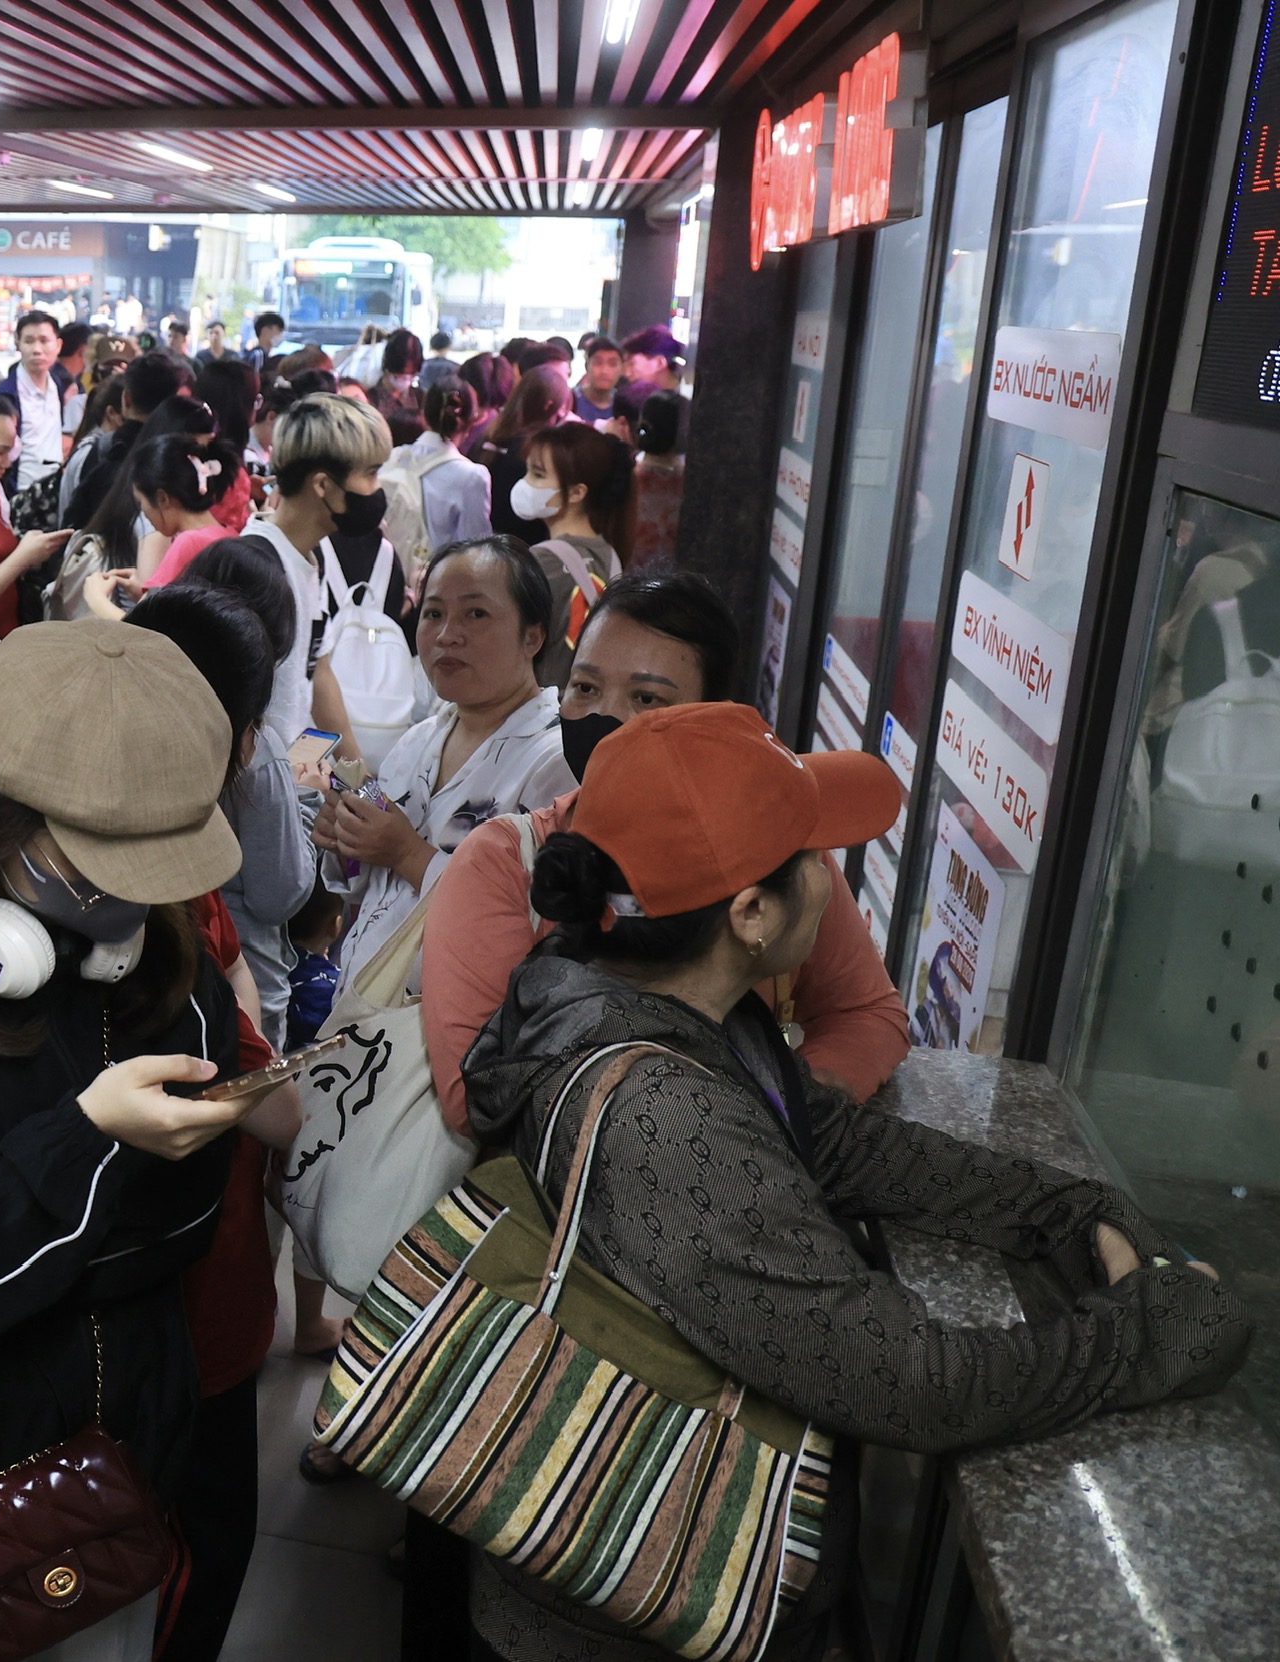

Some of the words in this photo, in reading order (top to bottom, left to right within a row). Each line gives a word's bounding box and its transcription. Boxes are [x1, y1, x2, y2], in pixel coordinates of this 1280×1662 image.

[16, 226, 72, 249] CAFÉ
[993, 359, 1014, 393] BX
[1012, 354, 1057, 403] NƯỚC
[1056, 353, 1112, 415] NGẦM
[963, 605, 983, 645] BX
[982, 613, 1014, 671] VĨNH
[1012, 643, 1053, 705] NIỆM
[942, 709, 965, 758] GIÁ
[967, 738, 988, 785] VÉ:
[993, 765, 1038, 843] 130K
